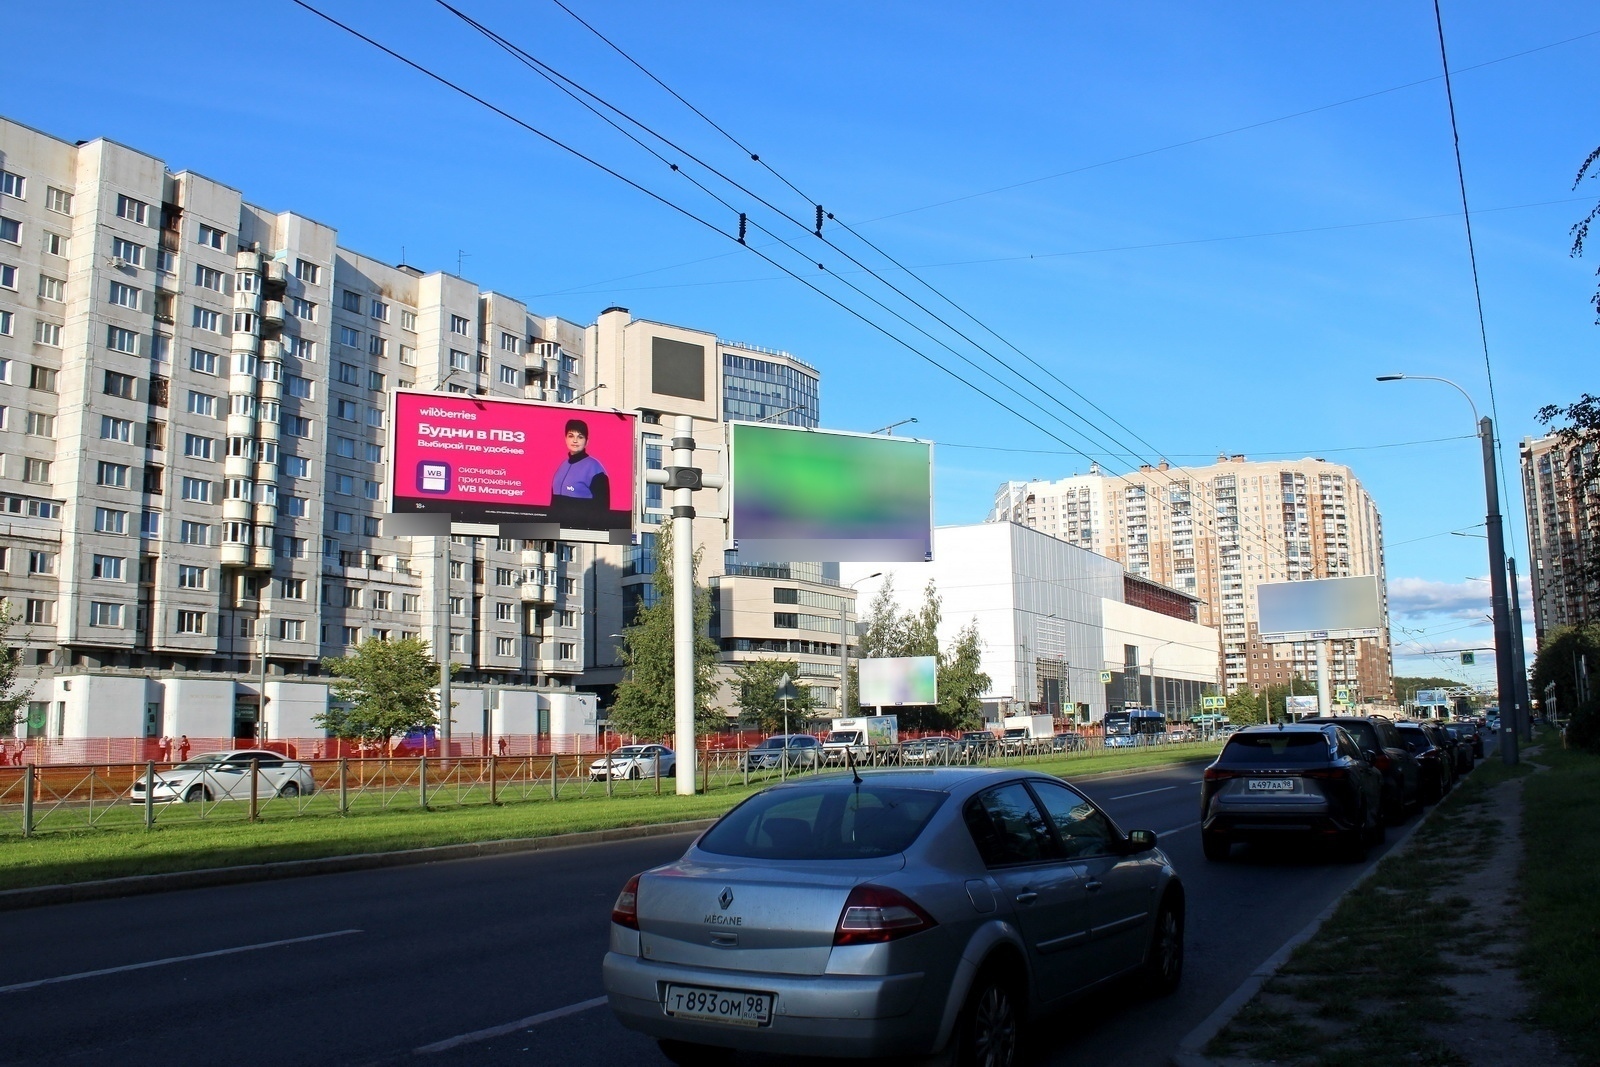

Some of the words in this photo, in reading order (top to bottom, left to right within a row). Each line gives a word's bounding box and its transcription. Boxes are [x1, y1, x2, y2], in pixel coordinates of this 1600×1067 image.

[420, 407, 477, 420] wildberries
[418, 422, 474, 438] Будни
[477, 431, 487, 440] в
[490, 429, 526, 443] ПВЗ
[417, 439, 465, 450] Выбирай
[465, 444, 482, 452] где
[483, 445, 525, 455] удобнее
[427, 469, 442, 477] WB
[458, 466, 507, 476] скачивай
[458, 476, 522, 487] приложение
[458, 485, 477, 493] WB
[478, 485, 525, 497] Manager
[746, 997, 763, 1013] 98
